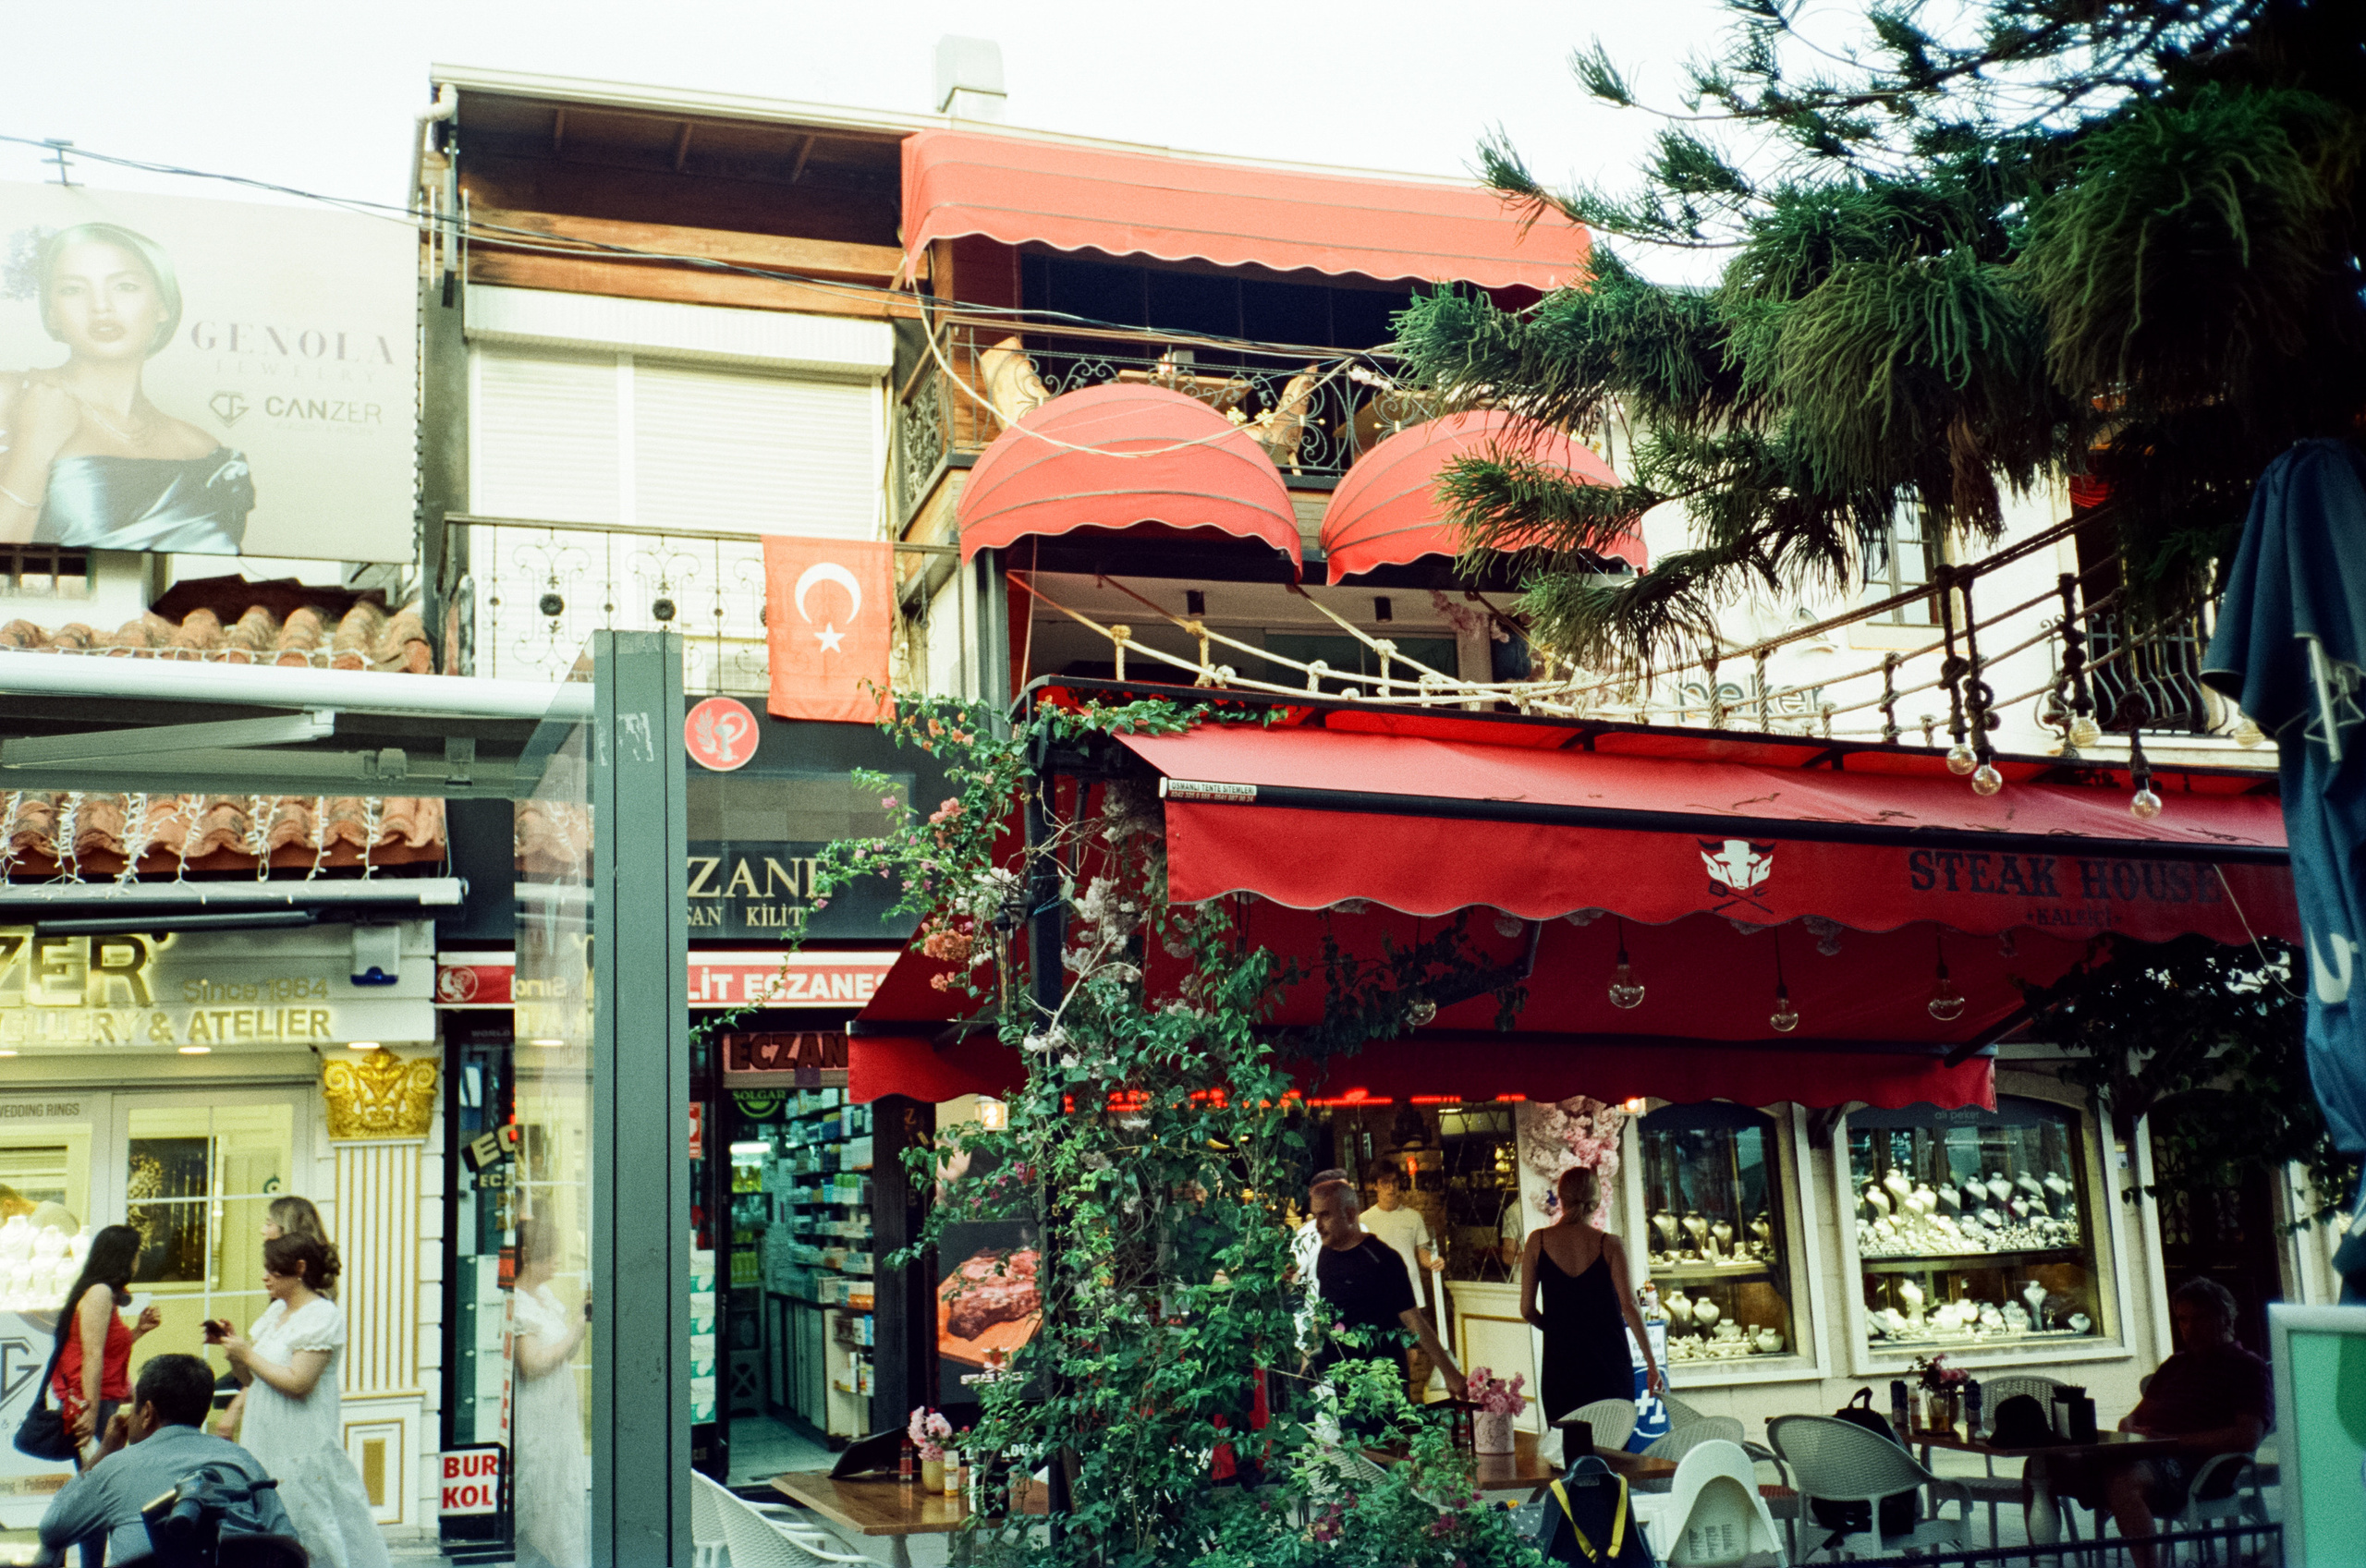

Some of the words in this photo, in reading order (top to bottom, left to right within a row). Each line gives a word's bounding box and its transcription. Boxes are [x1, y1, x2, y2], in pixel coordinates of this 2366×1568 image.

[190, 321, 394, 365] GENOLA
[215, 359, 375, 383] JEWELRY
[264, 395, 383, 425] CANZER
[1171, 782, 1201, 791] OSMANLI
[1201, 784, 1222, 793] TENTE
[1908, 849, 2062, 898] STEAK
[2078, 858, 2222, 904] HOUSE
[746, 903, 804, 927] KİLİT
[185, 978, 258, 1003] Since
[148, 1011, 174, 1042] &
[187, 1008, 332, 1042] ATELIER
[732, 1089, 786, 1100] SOLGAR
[45, 1102, 81, 1116] RINGS
[442, 1484, 499, 1510] KOL
